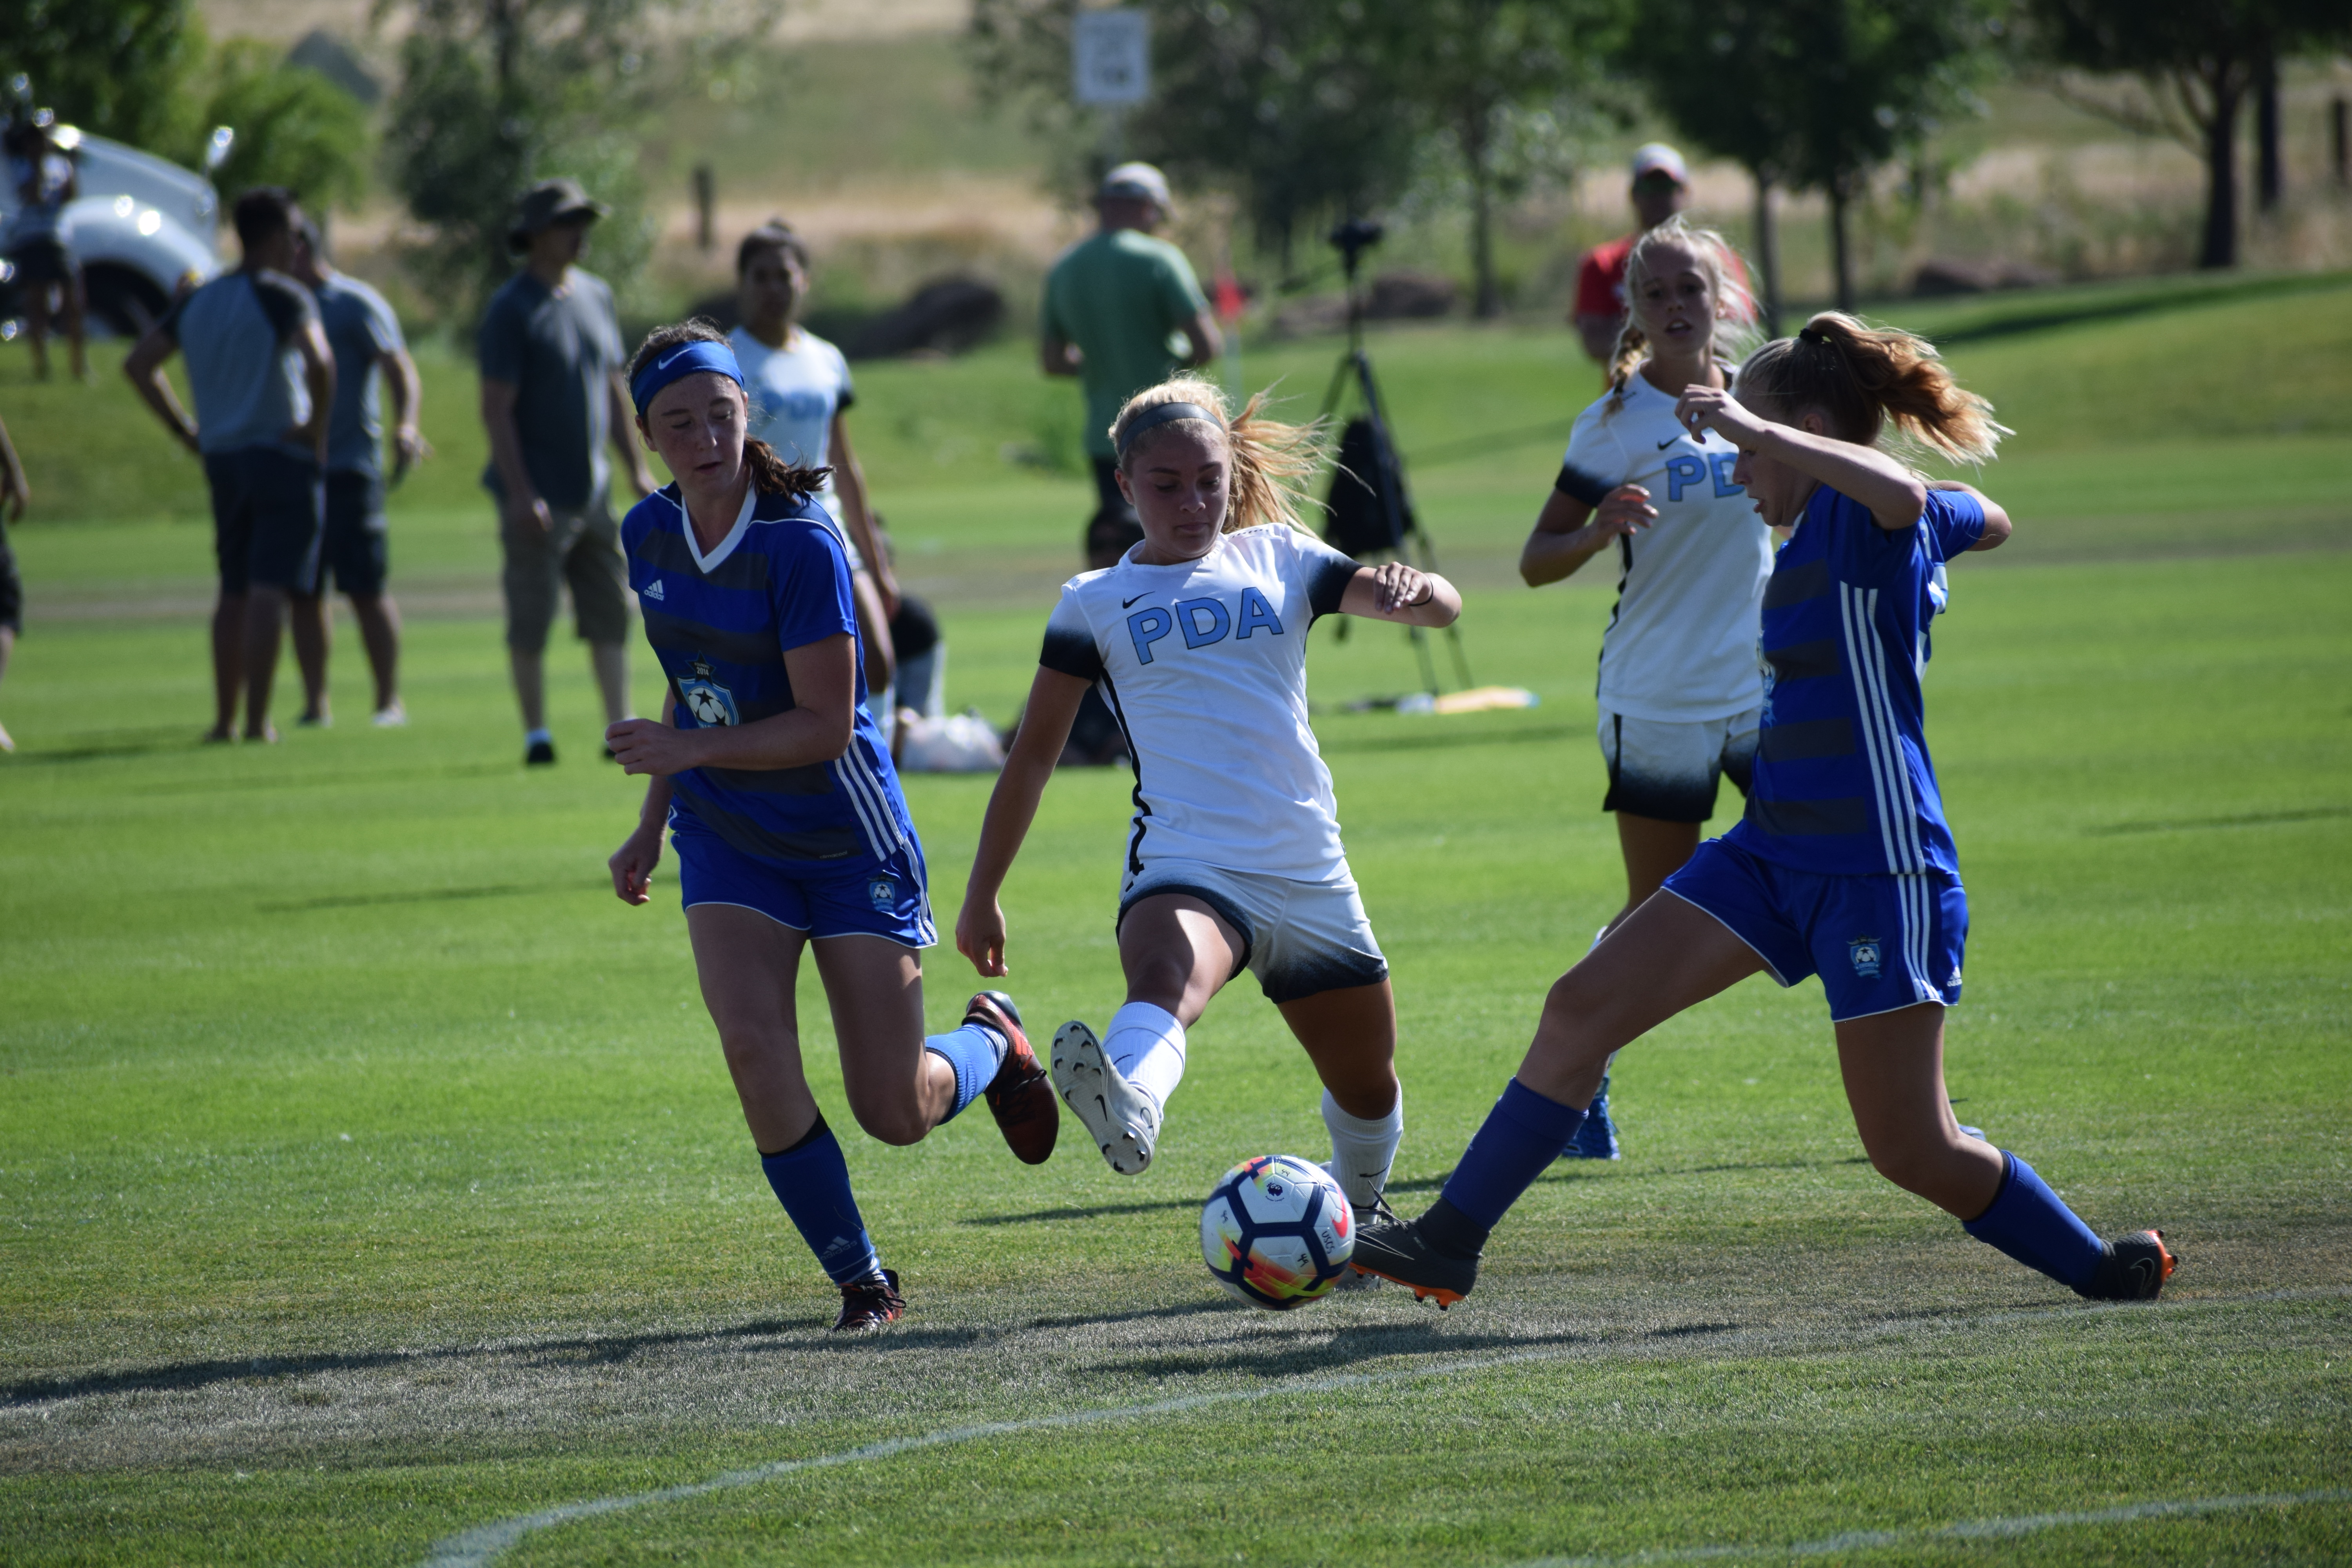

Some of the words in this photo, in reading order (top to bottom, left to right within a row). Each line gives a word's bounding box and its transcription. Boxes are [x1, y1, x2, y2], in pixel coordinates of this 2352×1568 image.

[1666, 452, 1745, 502] PD
[644, 589, 664, 601] adidas
[1127, 586, 1284, 666] PDA
[697, 667, 709, 676] 2014
[819, 850, 848, 859] climacool
[820, 1241, 857, 1260] adidas
